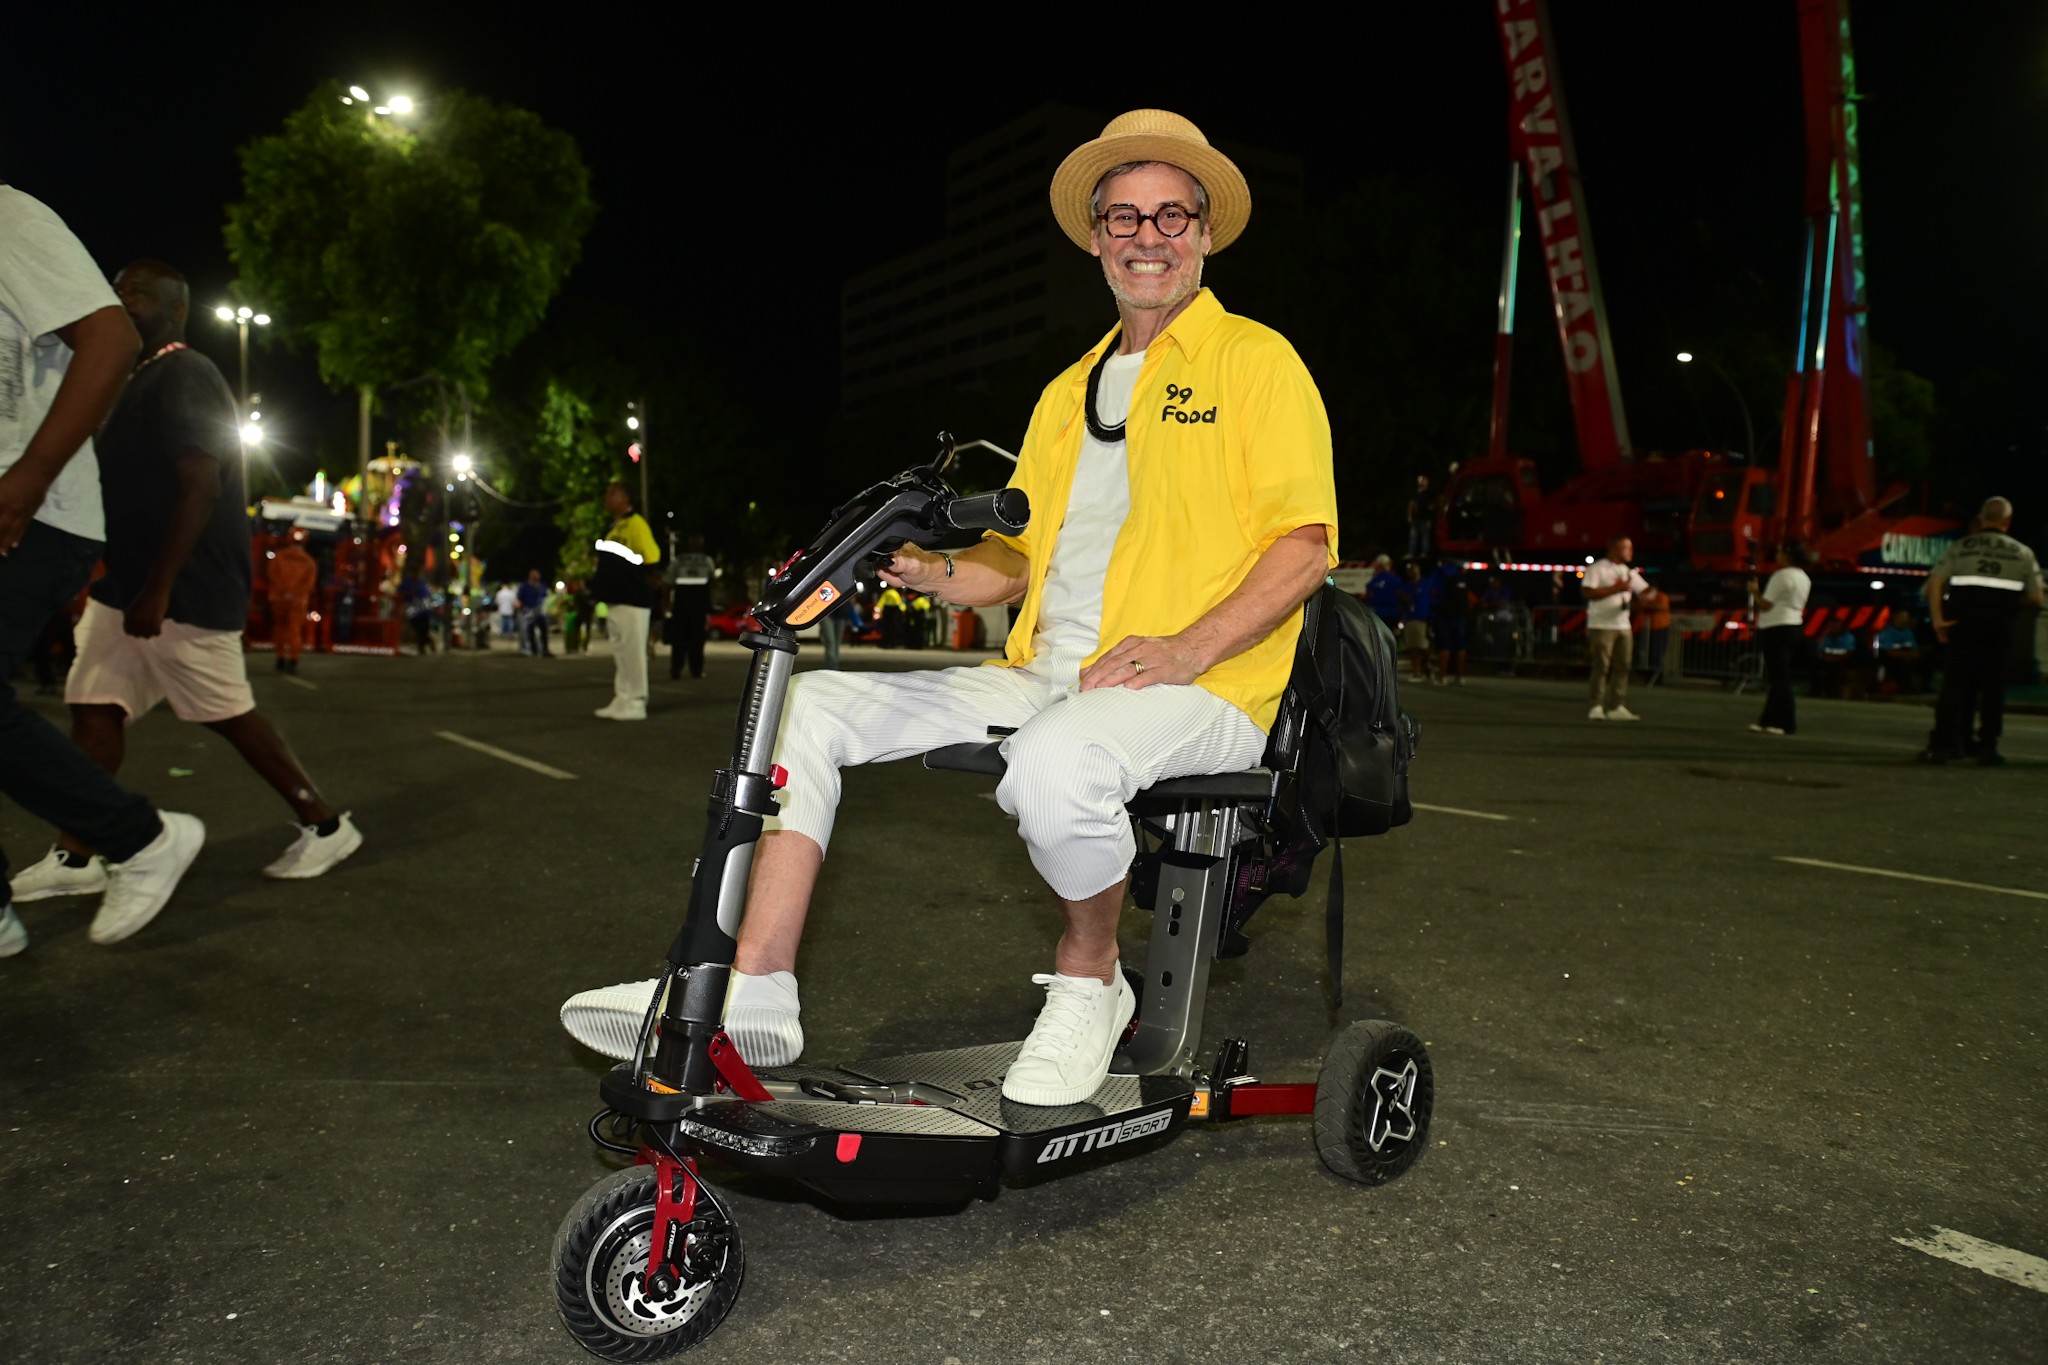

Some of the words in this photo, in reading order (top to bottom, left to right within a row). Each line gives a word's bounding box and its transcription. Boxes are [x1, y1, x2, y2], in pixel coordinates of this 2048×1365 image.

[1166, 383, 1193, 405] 99
[1161, 405, 1217, 424] Food
[1036, 1121, 1123, 1164] ATTO
[1119, 1115, 1172, 1142] SPORT
